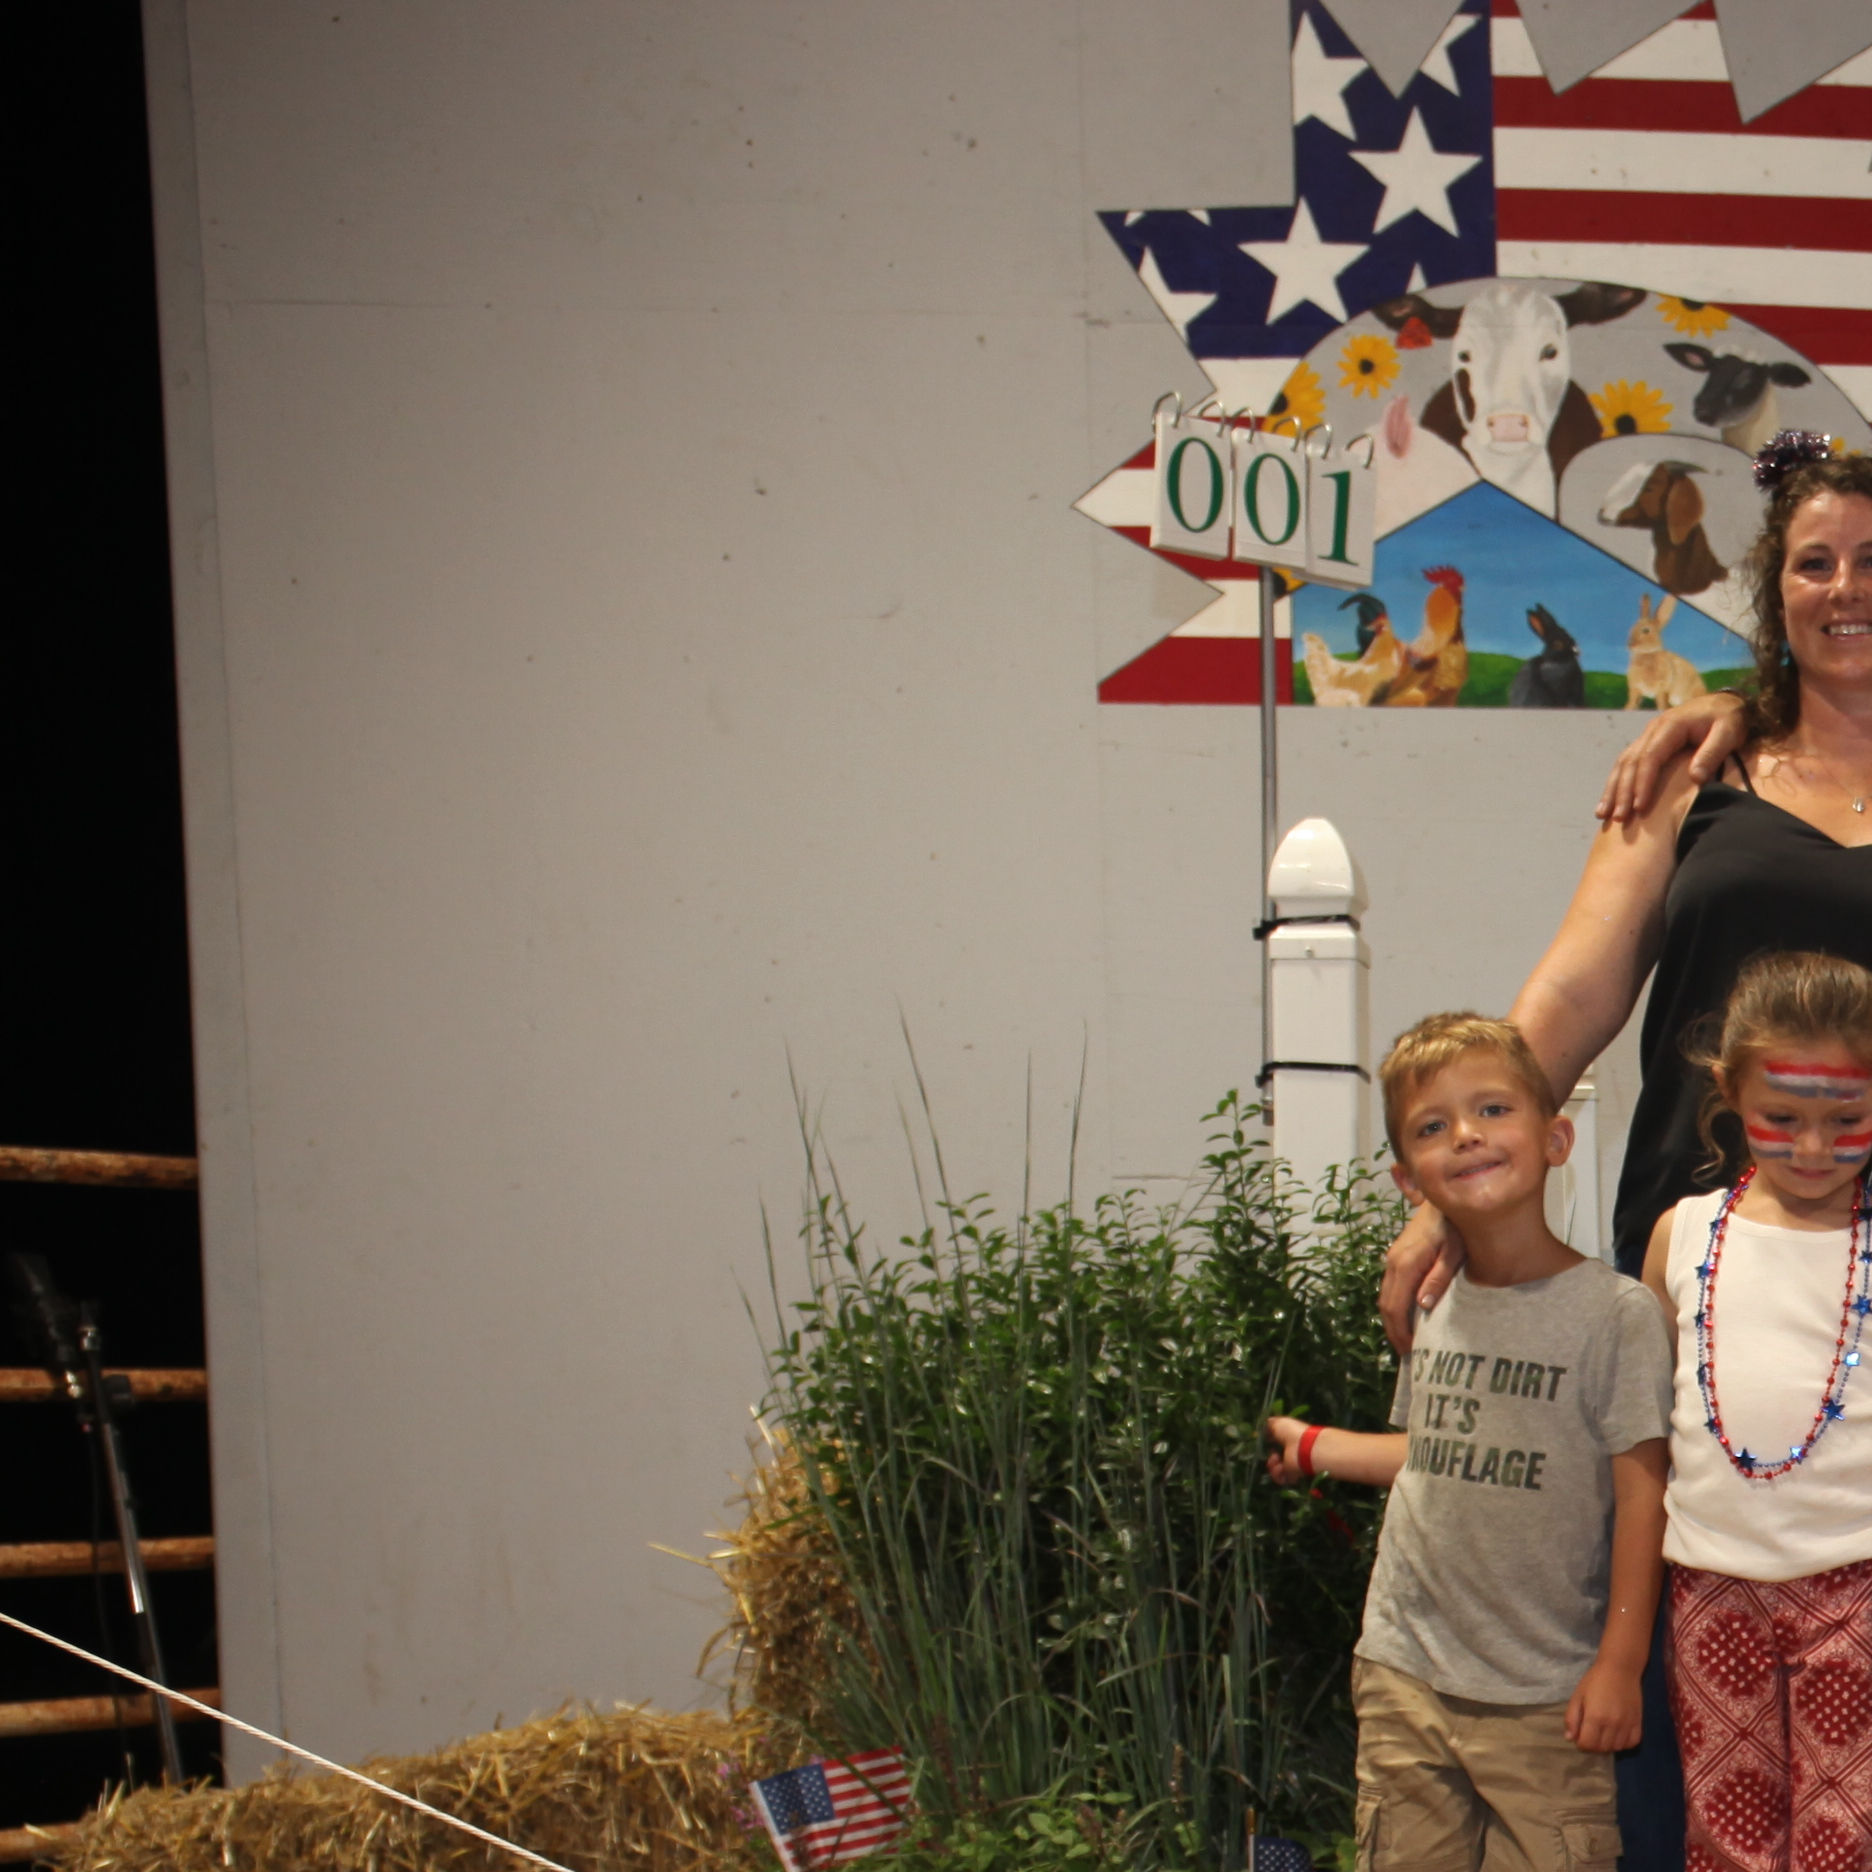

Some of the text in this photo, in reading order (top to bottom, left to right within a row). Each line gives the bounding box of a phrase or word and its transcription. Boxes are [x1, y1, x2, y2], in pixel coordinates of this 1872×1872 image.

[1167, 437, 1359, 566] 001
[1428, 1351, 1486, 1390] NOT
[1490, 1357, 1567, 1402] DIRT
[1425, 1393, 1480, 1434] IT'S
